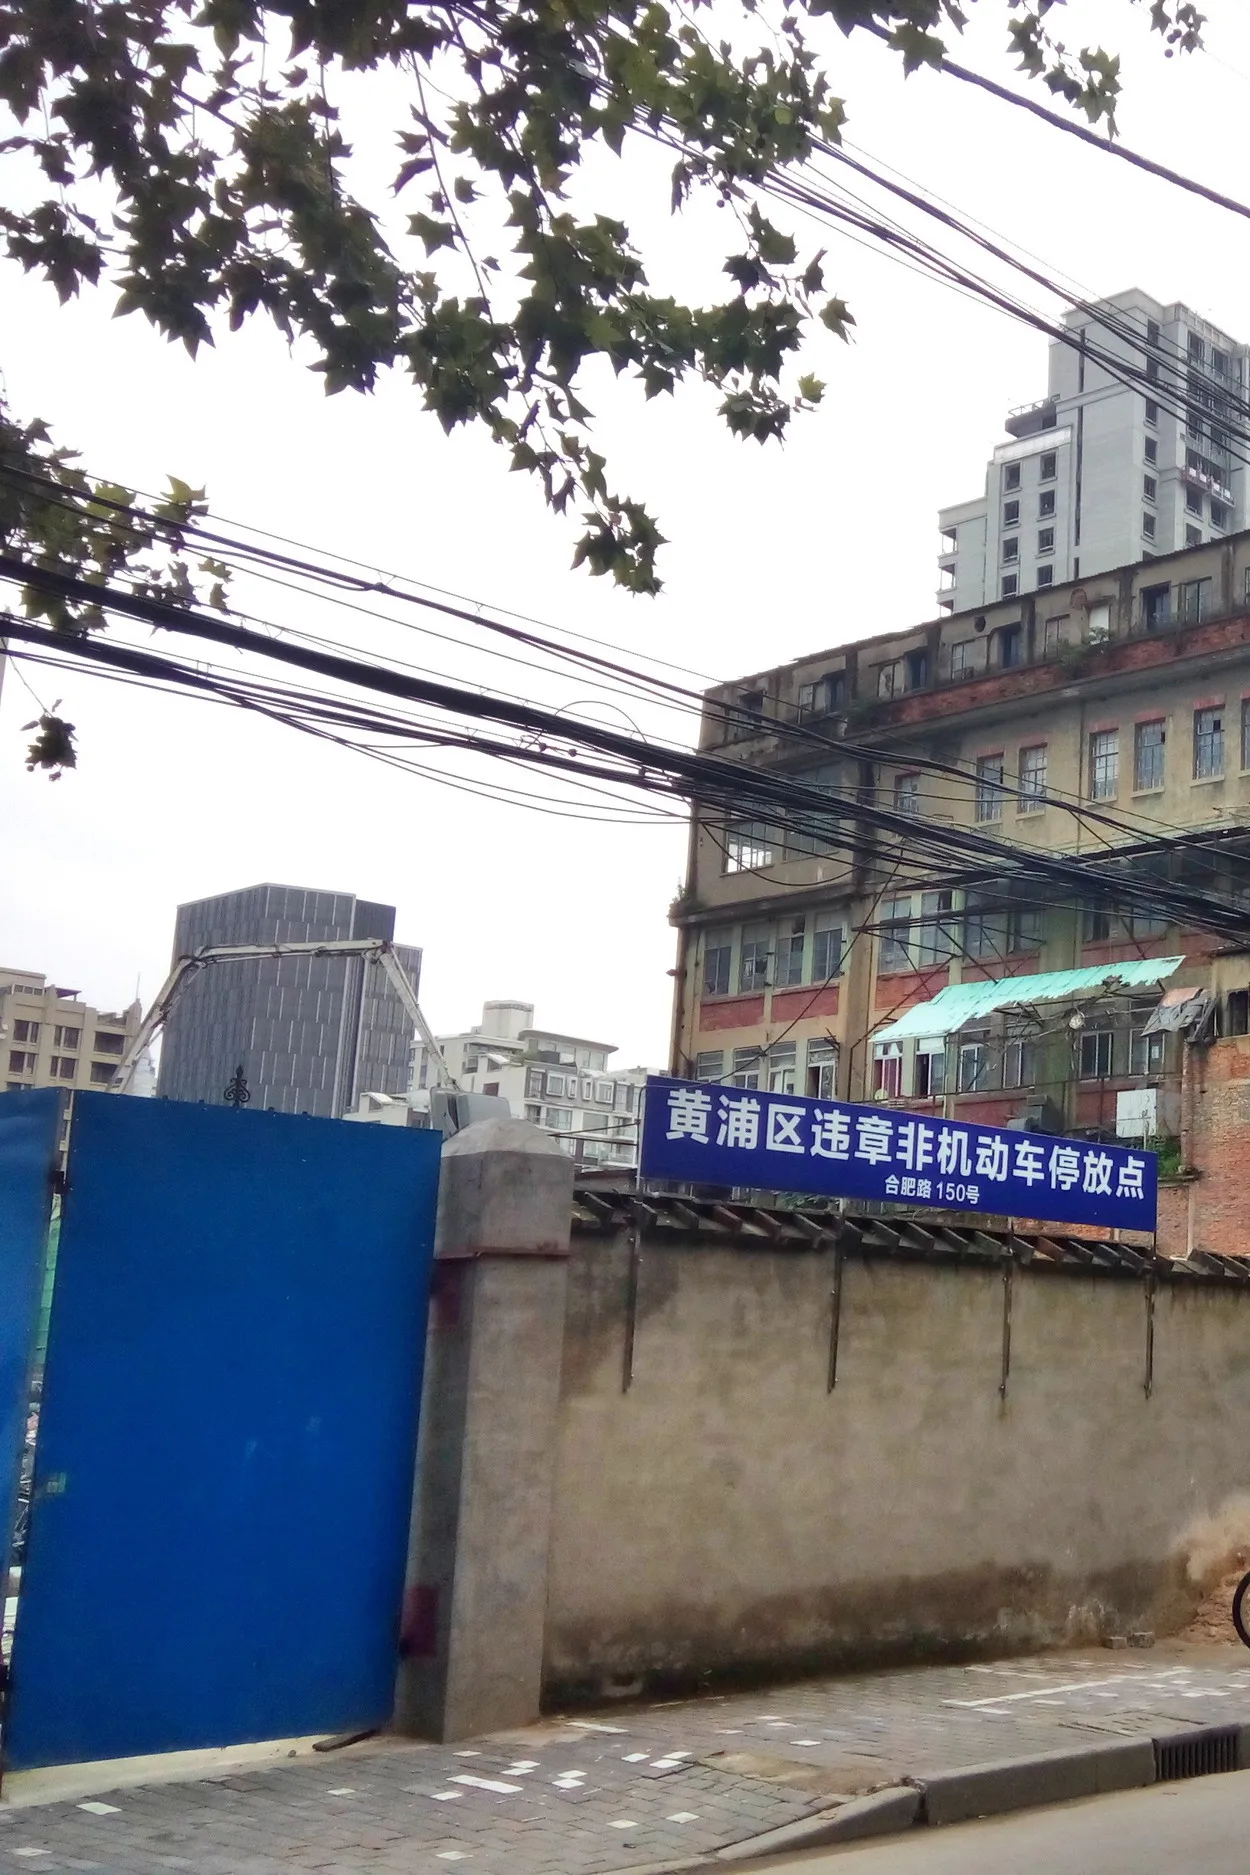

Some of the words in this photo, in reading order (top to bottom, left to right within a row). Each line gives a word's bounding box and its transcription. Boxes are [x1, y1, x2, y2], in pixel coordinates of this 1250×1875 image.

[666, 1088, 1145, 1200] 黄浦区违章非机动车停放点
